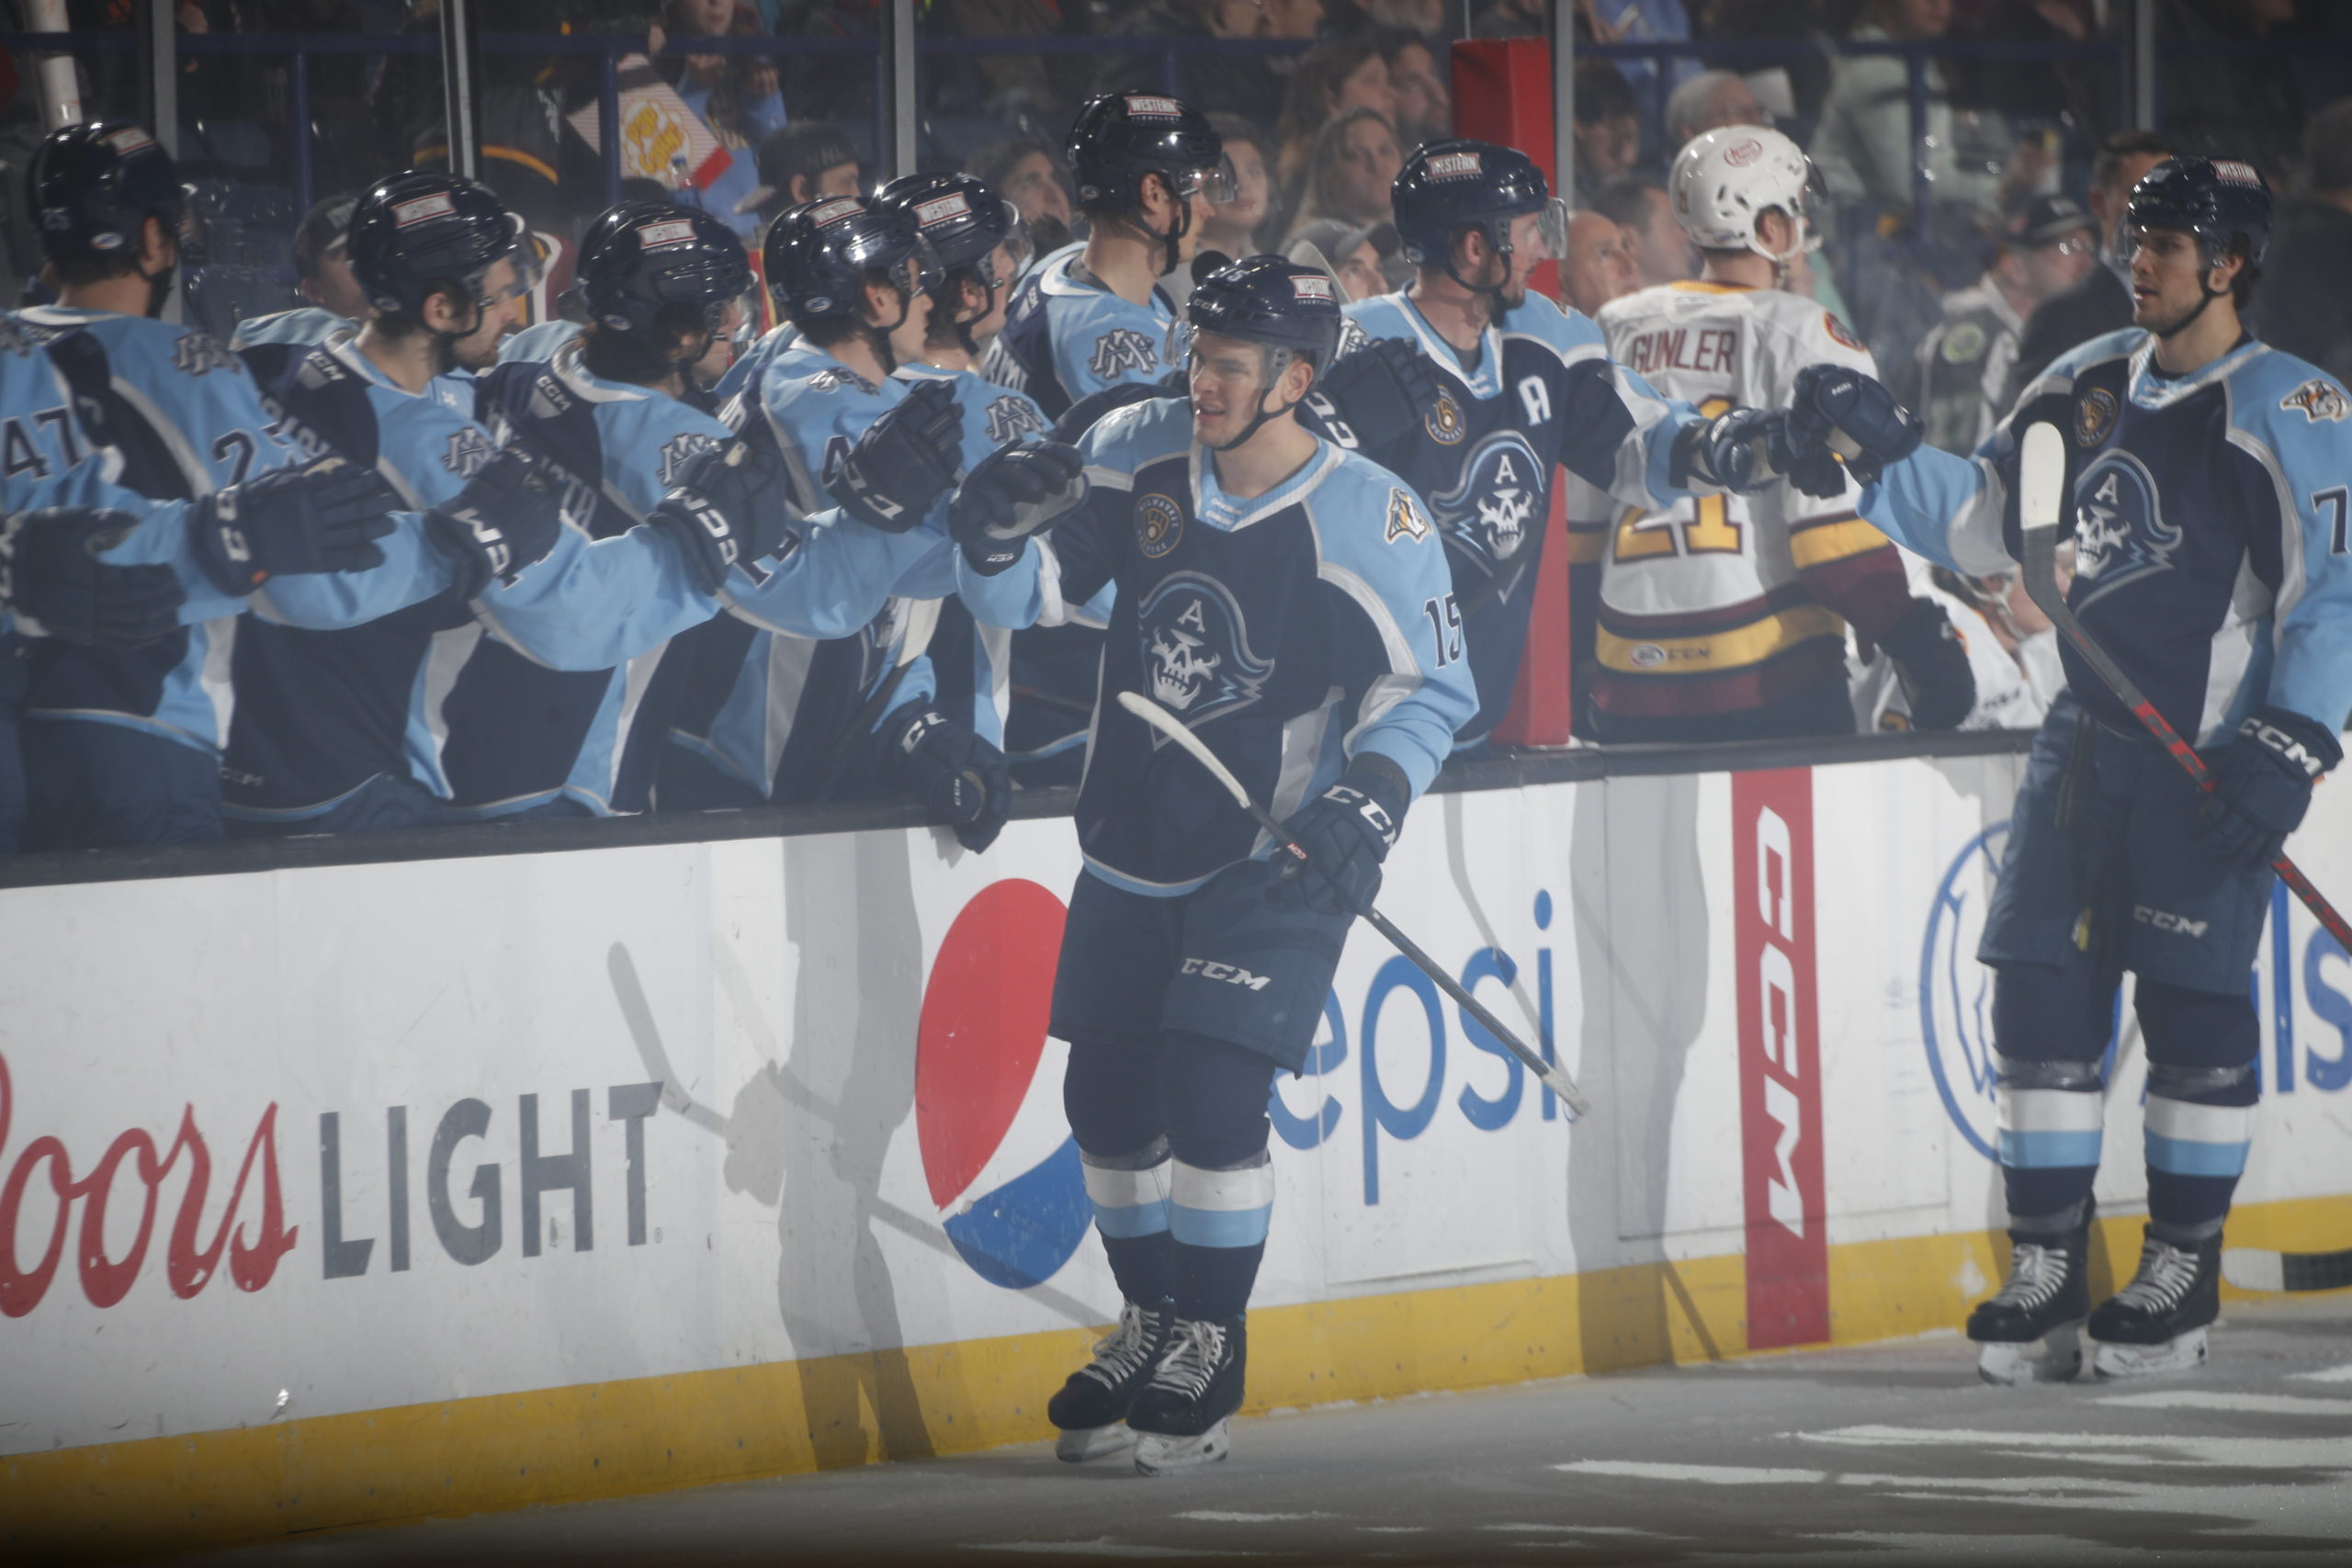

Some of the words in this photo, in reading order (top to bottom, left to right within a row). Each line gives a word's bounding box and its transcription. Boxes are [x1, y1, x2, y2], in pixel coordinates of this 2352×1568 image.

[1428, 154, 1480, 177] WESTERN
[1632, 329, 1737, 374] GUNLER
[1518, 374, 1553, 427] A
[2, 405, 85, 483] 47
[1494, 454, 1519, 486] A
[2094, 471, 2119, 505] A
[1177, 598, 1206, 634] A
[1422, 592, 1463, 671] 15
[2238, 716, 2323, 777] CCM
[2132, 904, 2211, 939] CCM
[1181, 957, 1272, 992] CCM
[1266, 887, 1557, 1206] epsi
[1756, 805, 1804, 1240] CCM
[0, 1048, 300, 1318] oors
[319, 1080, 665, 1281] LIGHT
